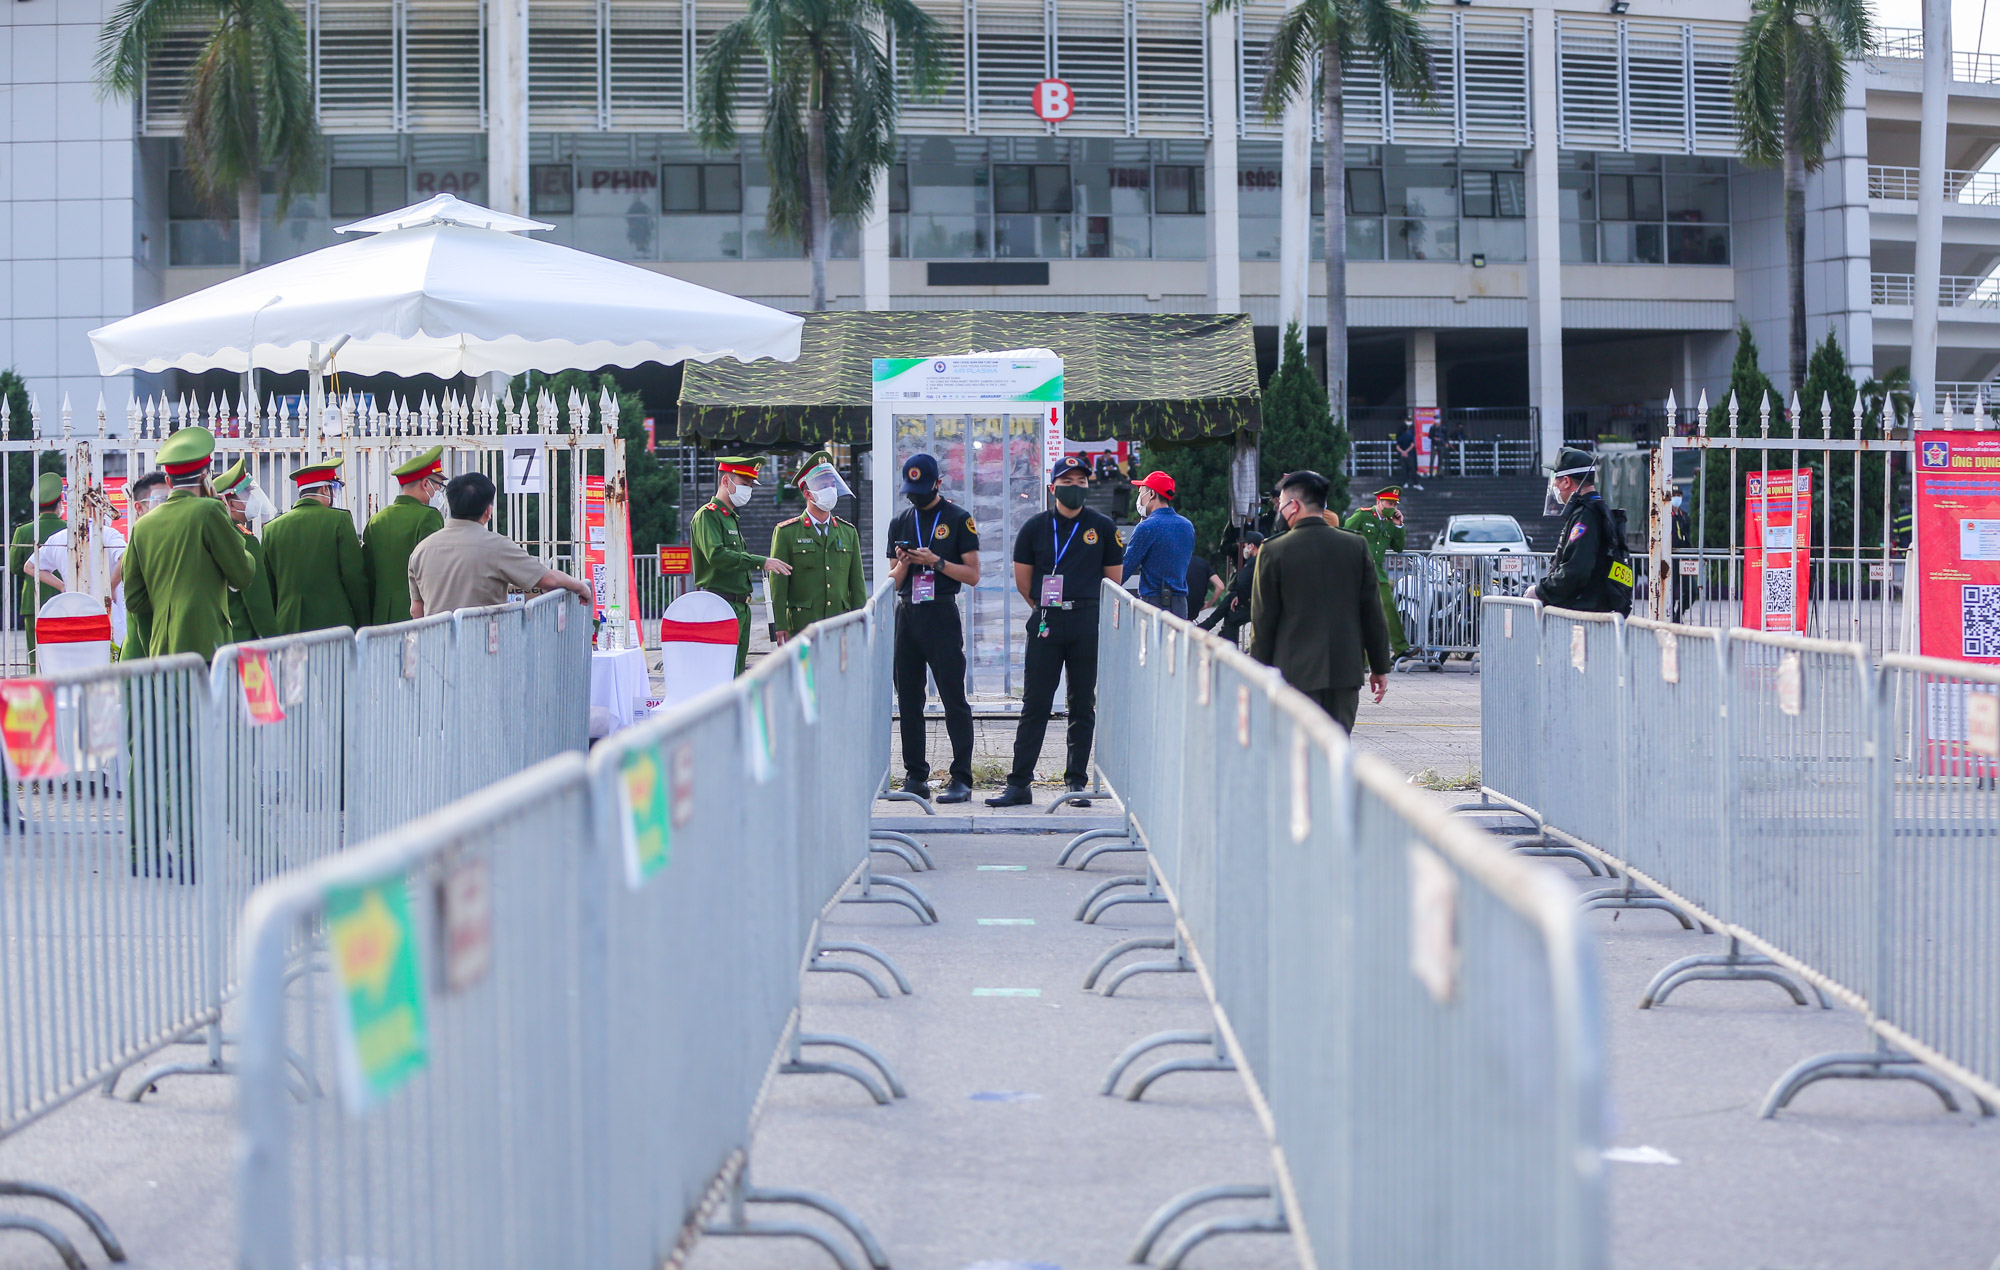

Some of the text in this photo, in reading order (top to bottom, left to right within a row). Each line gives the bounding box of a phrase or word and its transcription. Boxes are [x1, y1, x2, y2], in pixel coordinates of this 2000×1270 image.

[1041, 82, 1070, 118] B
[513, 448, 537, 485] 7
[1951, 454, 2000, 470] ỨNG DỤNG
